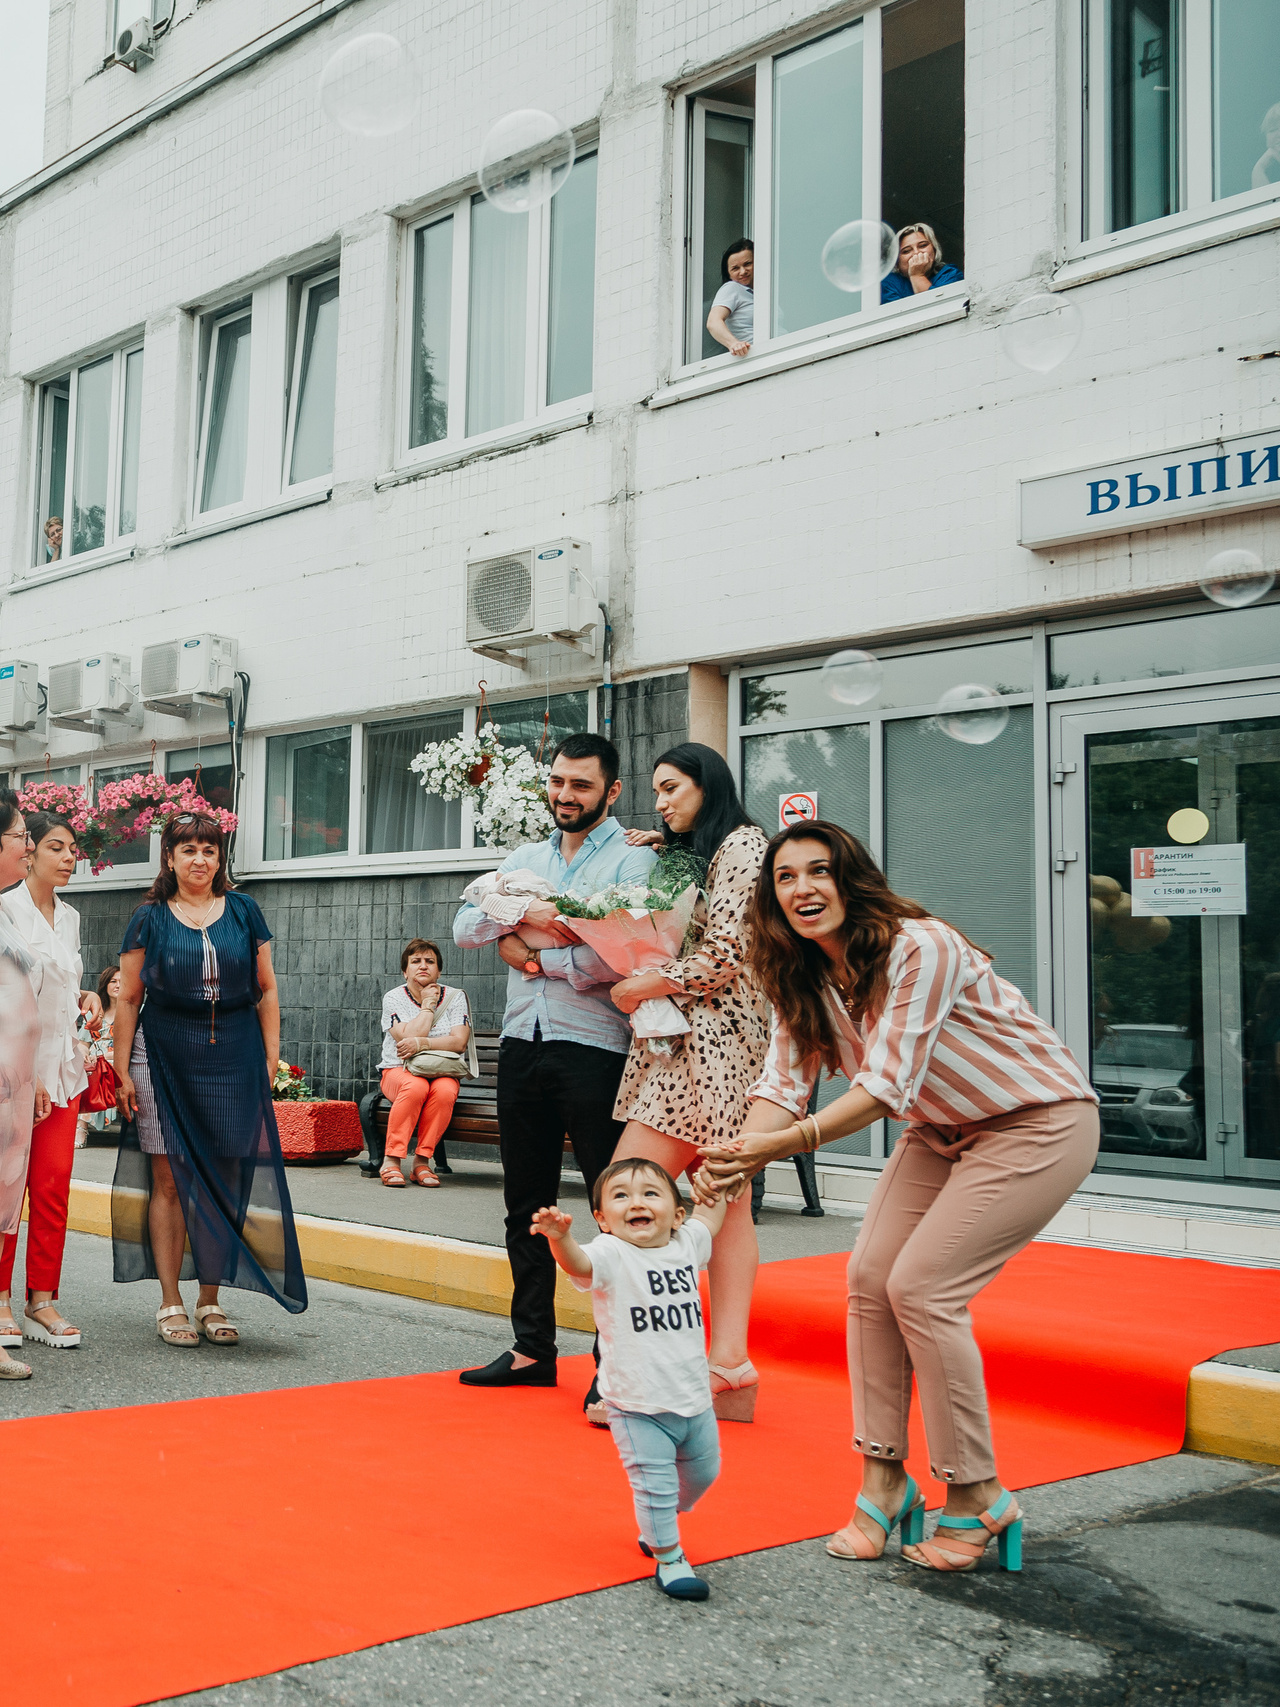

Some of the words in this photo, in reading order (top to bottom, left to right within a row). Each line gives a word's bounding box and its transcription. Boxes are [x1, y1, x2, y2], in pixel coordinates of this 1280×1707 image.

[1148, 852, 1194, 861] КАРАНТИН
[1163, 887, 1185, 895] 15:00
[1199, 886, 1222, 894] 19:00
[647, 1264, 698, 1296] BEST
